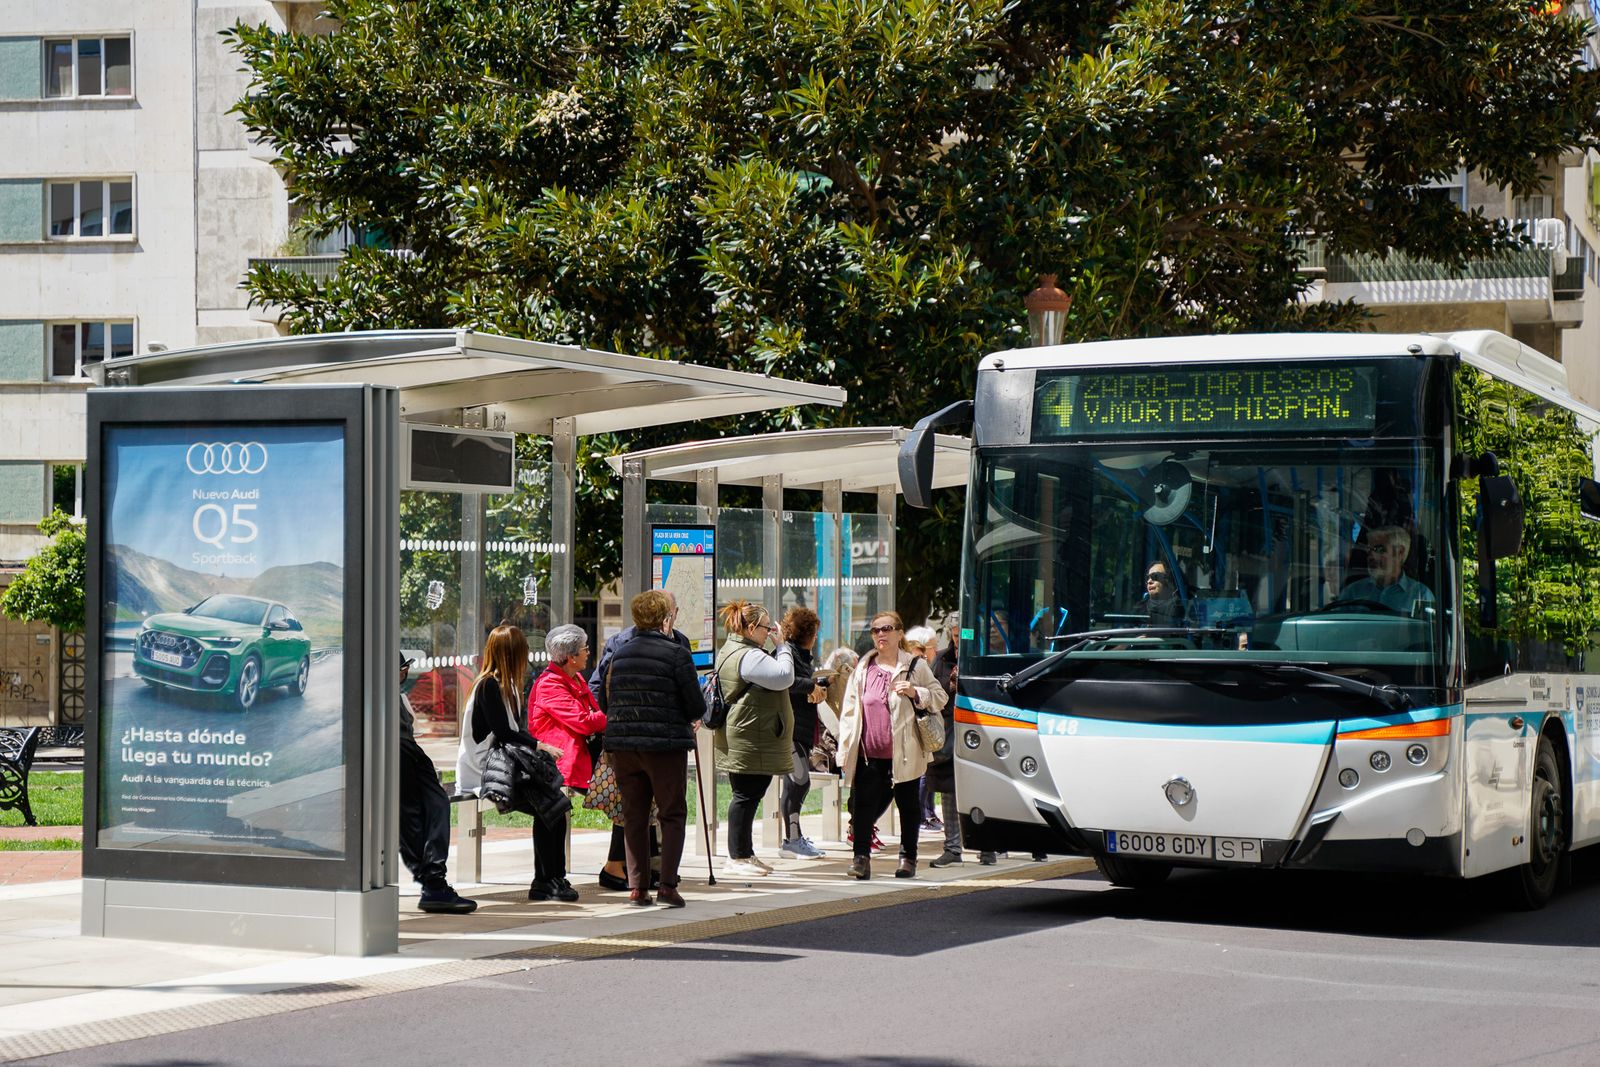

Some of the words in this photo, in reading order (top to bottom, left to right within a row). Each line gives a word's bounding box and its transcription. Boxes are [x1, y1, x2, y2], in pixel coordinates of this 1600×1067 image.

[1083, 368, 1353, 399] ZAFRA-TARTESSOS
[1040, 376, 1073, 427] 4
[192, 489, 229, 500] Nuevo
[230, 488, 260, 500] Audi
[192, 503, 258, 550] Q5
[192, 552, 257, 567] Sportback
[973, 703, 1020, 718] Castrosua
[121, 727, 183, 745] ¿Hasta
[187, 729, 246, 745] dónde
[1046, 719, 1079, 735] 148
[121, 747, 167, 766] llega
[172, 750, 192, 764] tu
[196, 751, 273, 767] mundo?
[121, 774, 143, 783] Audi
[144, 775, 152, 783] A
[153, 775, 162, 784] la
[163, 777, 212, 787] vanguardia
[212, 778, 224, 786] de
[226, 778, 235, 787] la
[236, 778, 273, 788] técnica.
[1119, 834, 1166, 853] 6008
[1172, 837, 1207, 855] GDY
